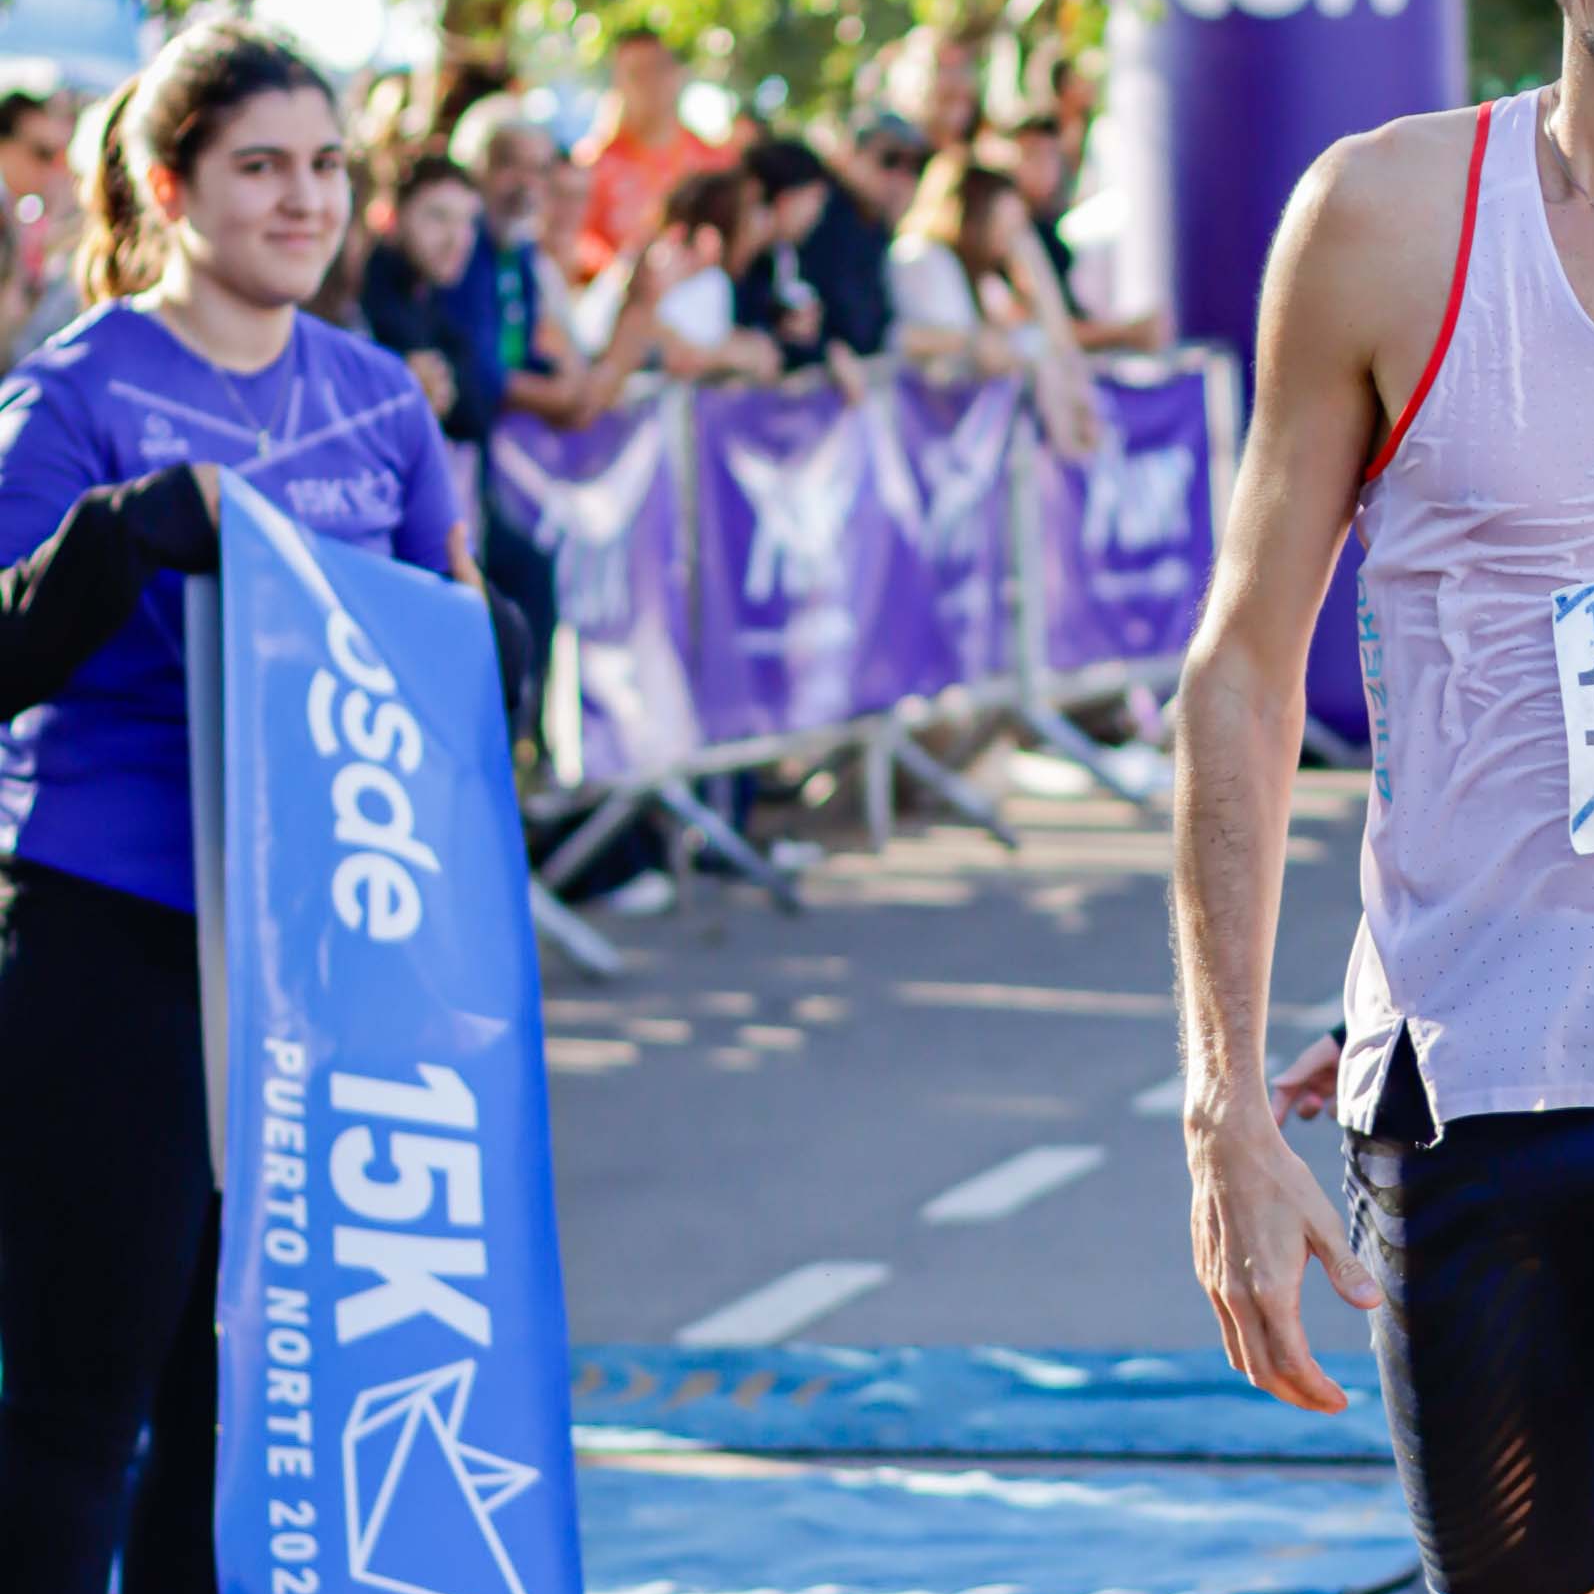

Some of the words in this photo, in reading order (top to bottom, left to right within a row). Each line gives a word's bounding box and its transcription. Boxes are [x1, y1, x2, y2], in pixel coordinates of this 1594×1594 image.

[263, 1036, 308, 1267] PUERTO
[329, 1061, 491, 1349] 15K
[266, 1285, 314, 1479] NORTE
